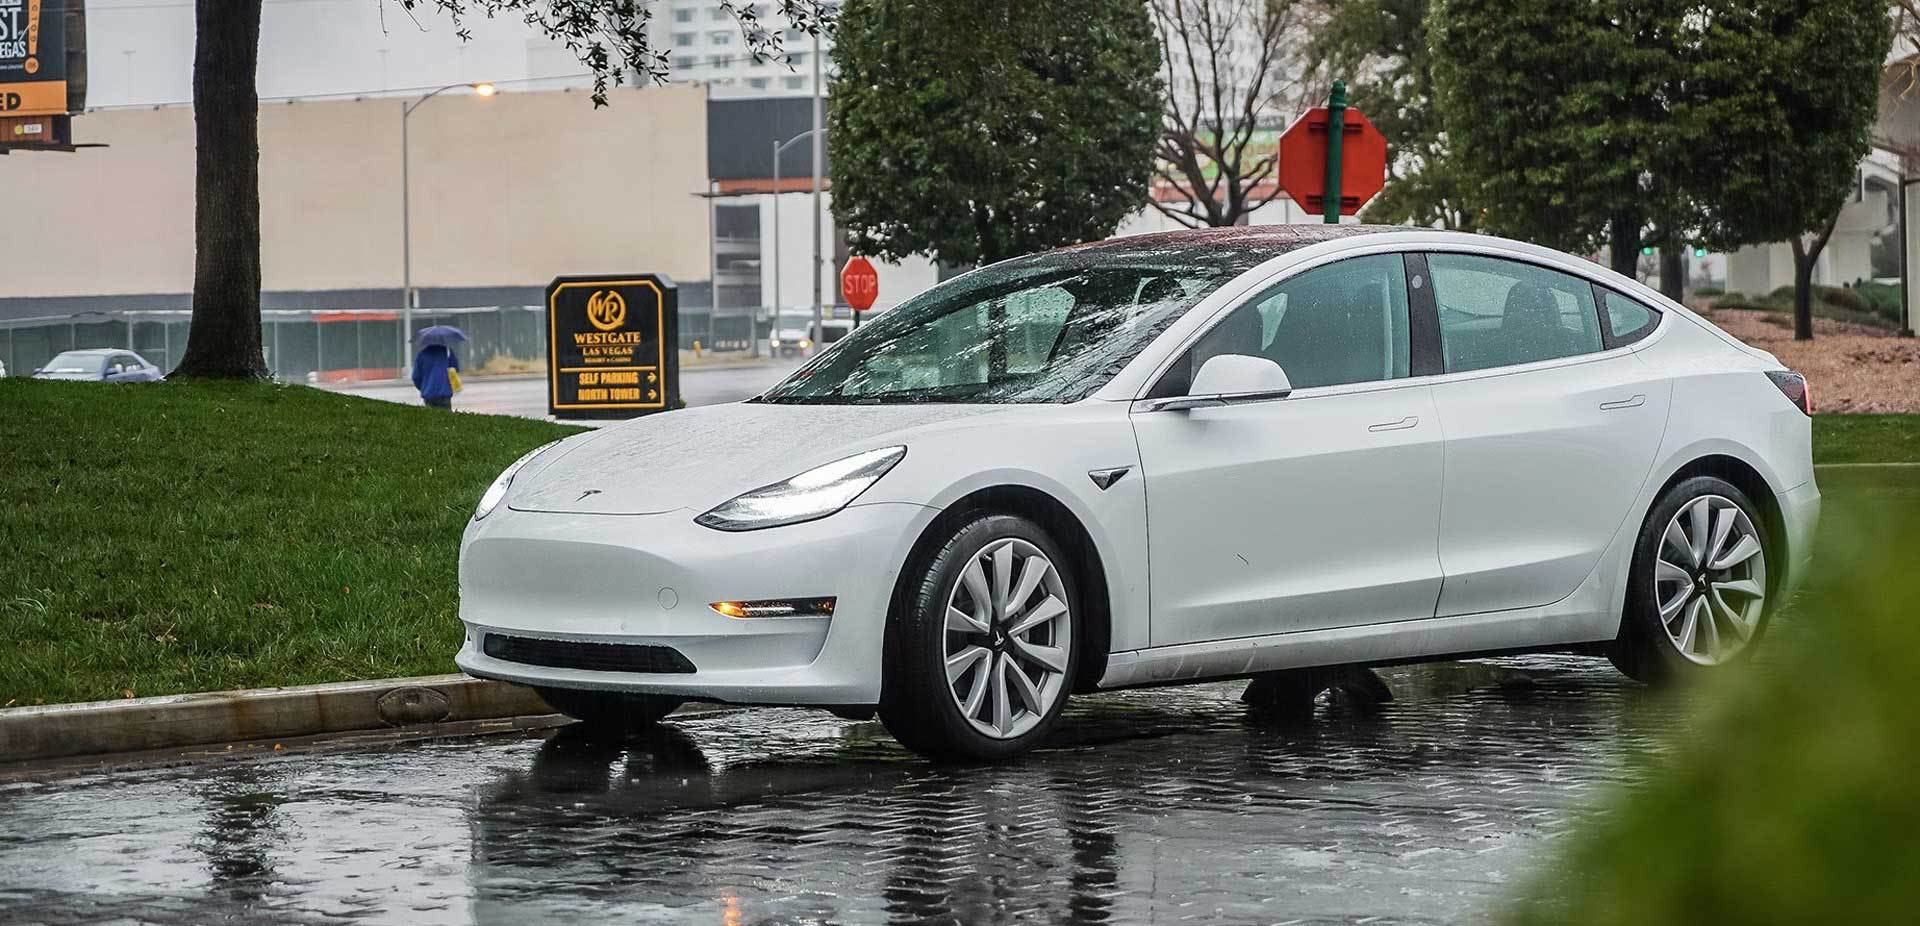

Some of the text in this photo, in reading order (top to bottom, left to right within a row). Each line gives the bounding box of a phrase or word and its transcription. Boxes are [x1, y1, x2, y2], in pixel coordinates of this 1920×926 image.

[845, 274, 876, 294] STOP
[574, 331, 641, 344] WESTGATE
[582, 346, 633, 356] LAS VEGAS
[579, 371, 639, 385] SELF PARKING
[578, 387, 640, 400] NORTH TOWER
